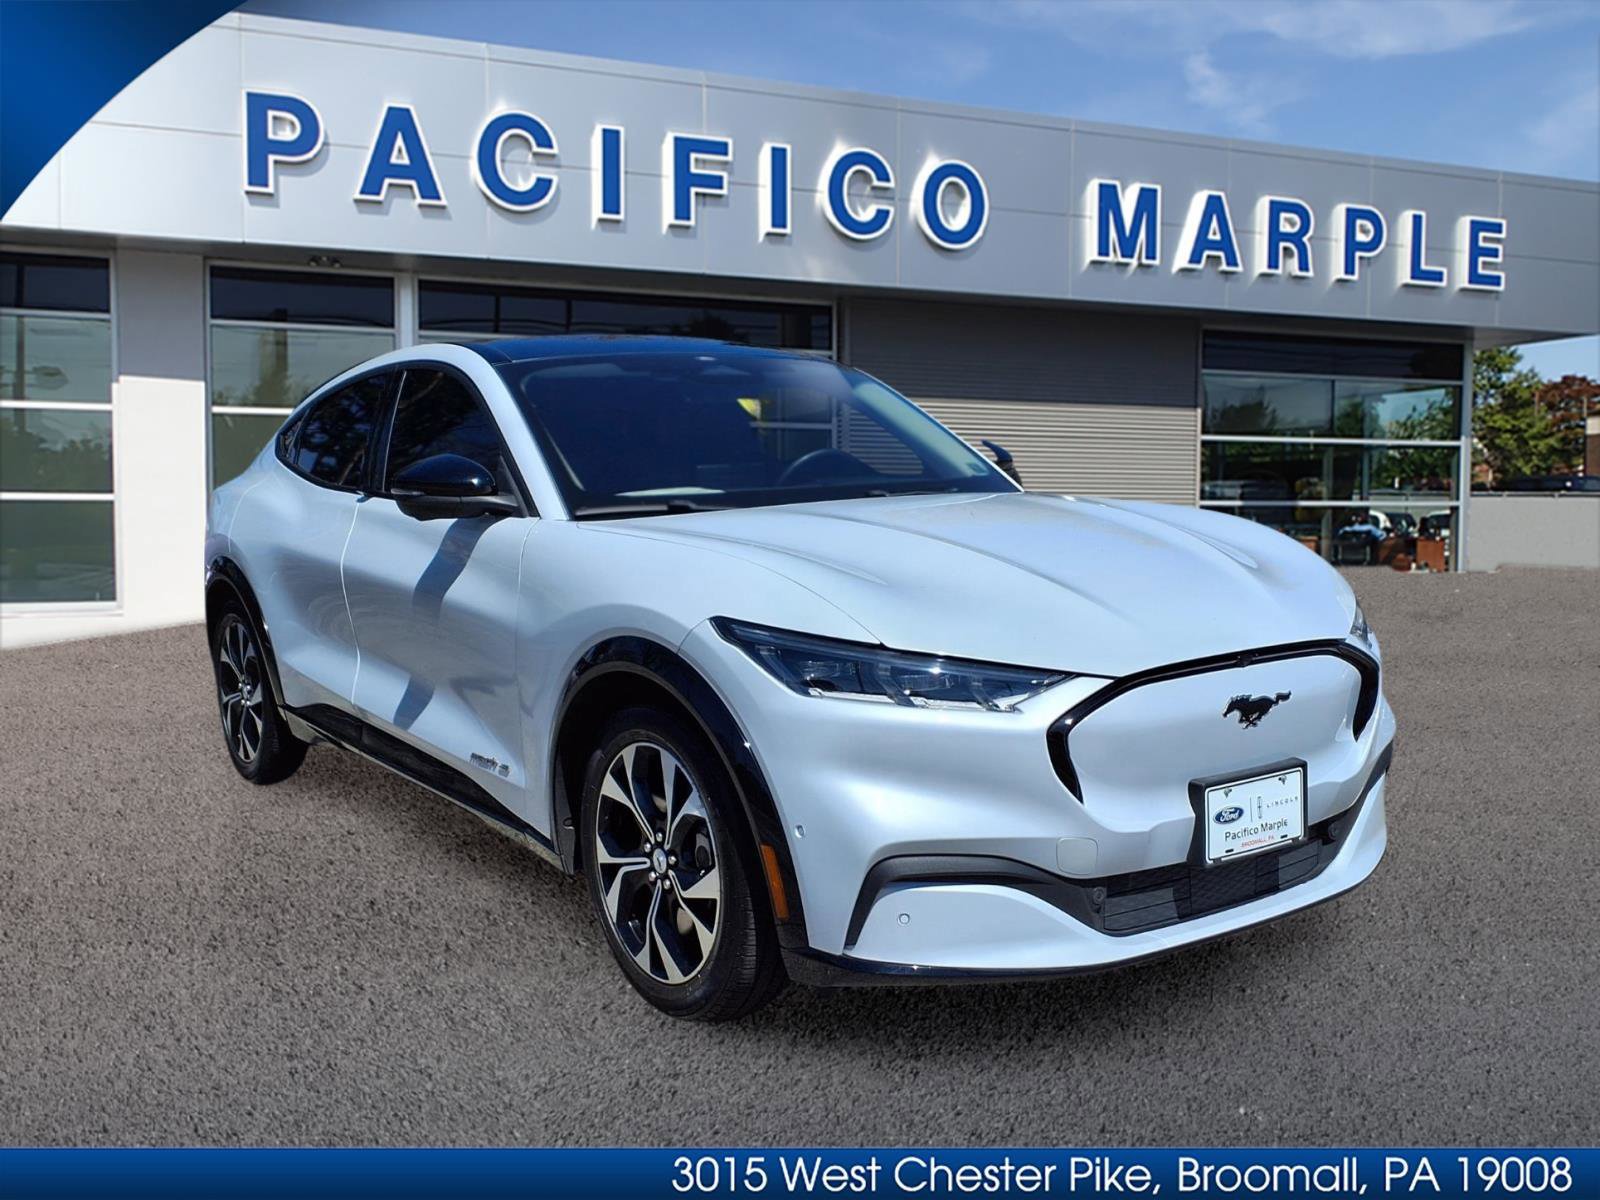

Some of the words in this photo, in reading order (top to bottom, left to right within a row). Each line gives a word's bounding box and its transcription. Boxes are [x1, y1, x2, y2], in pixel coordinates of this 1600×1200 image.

[241, 89, 990, 251] PACIFICO
[1084, 177, 1508, 292] MARPLE
[1224, 826, 1259, 842] Pacifico
[1260, 817, 1288, 833] Marple
